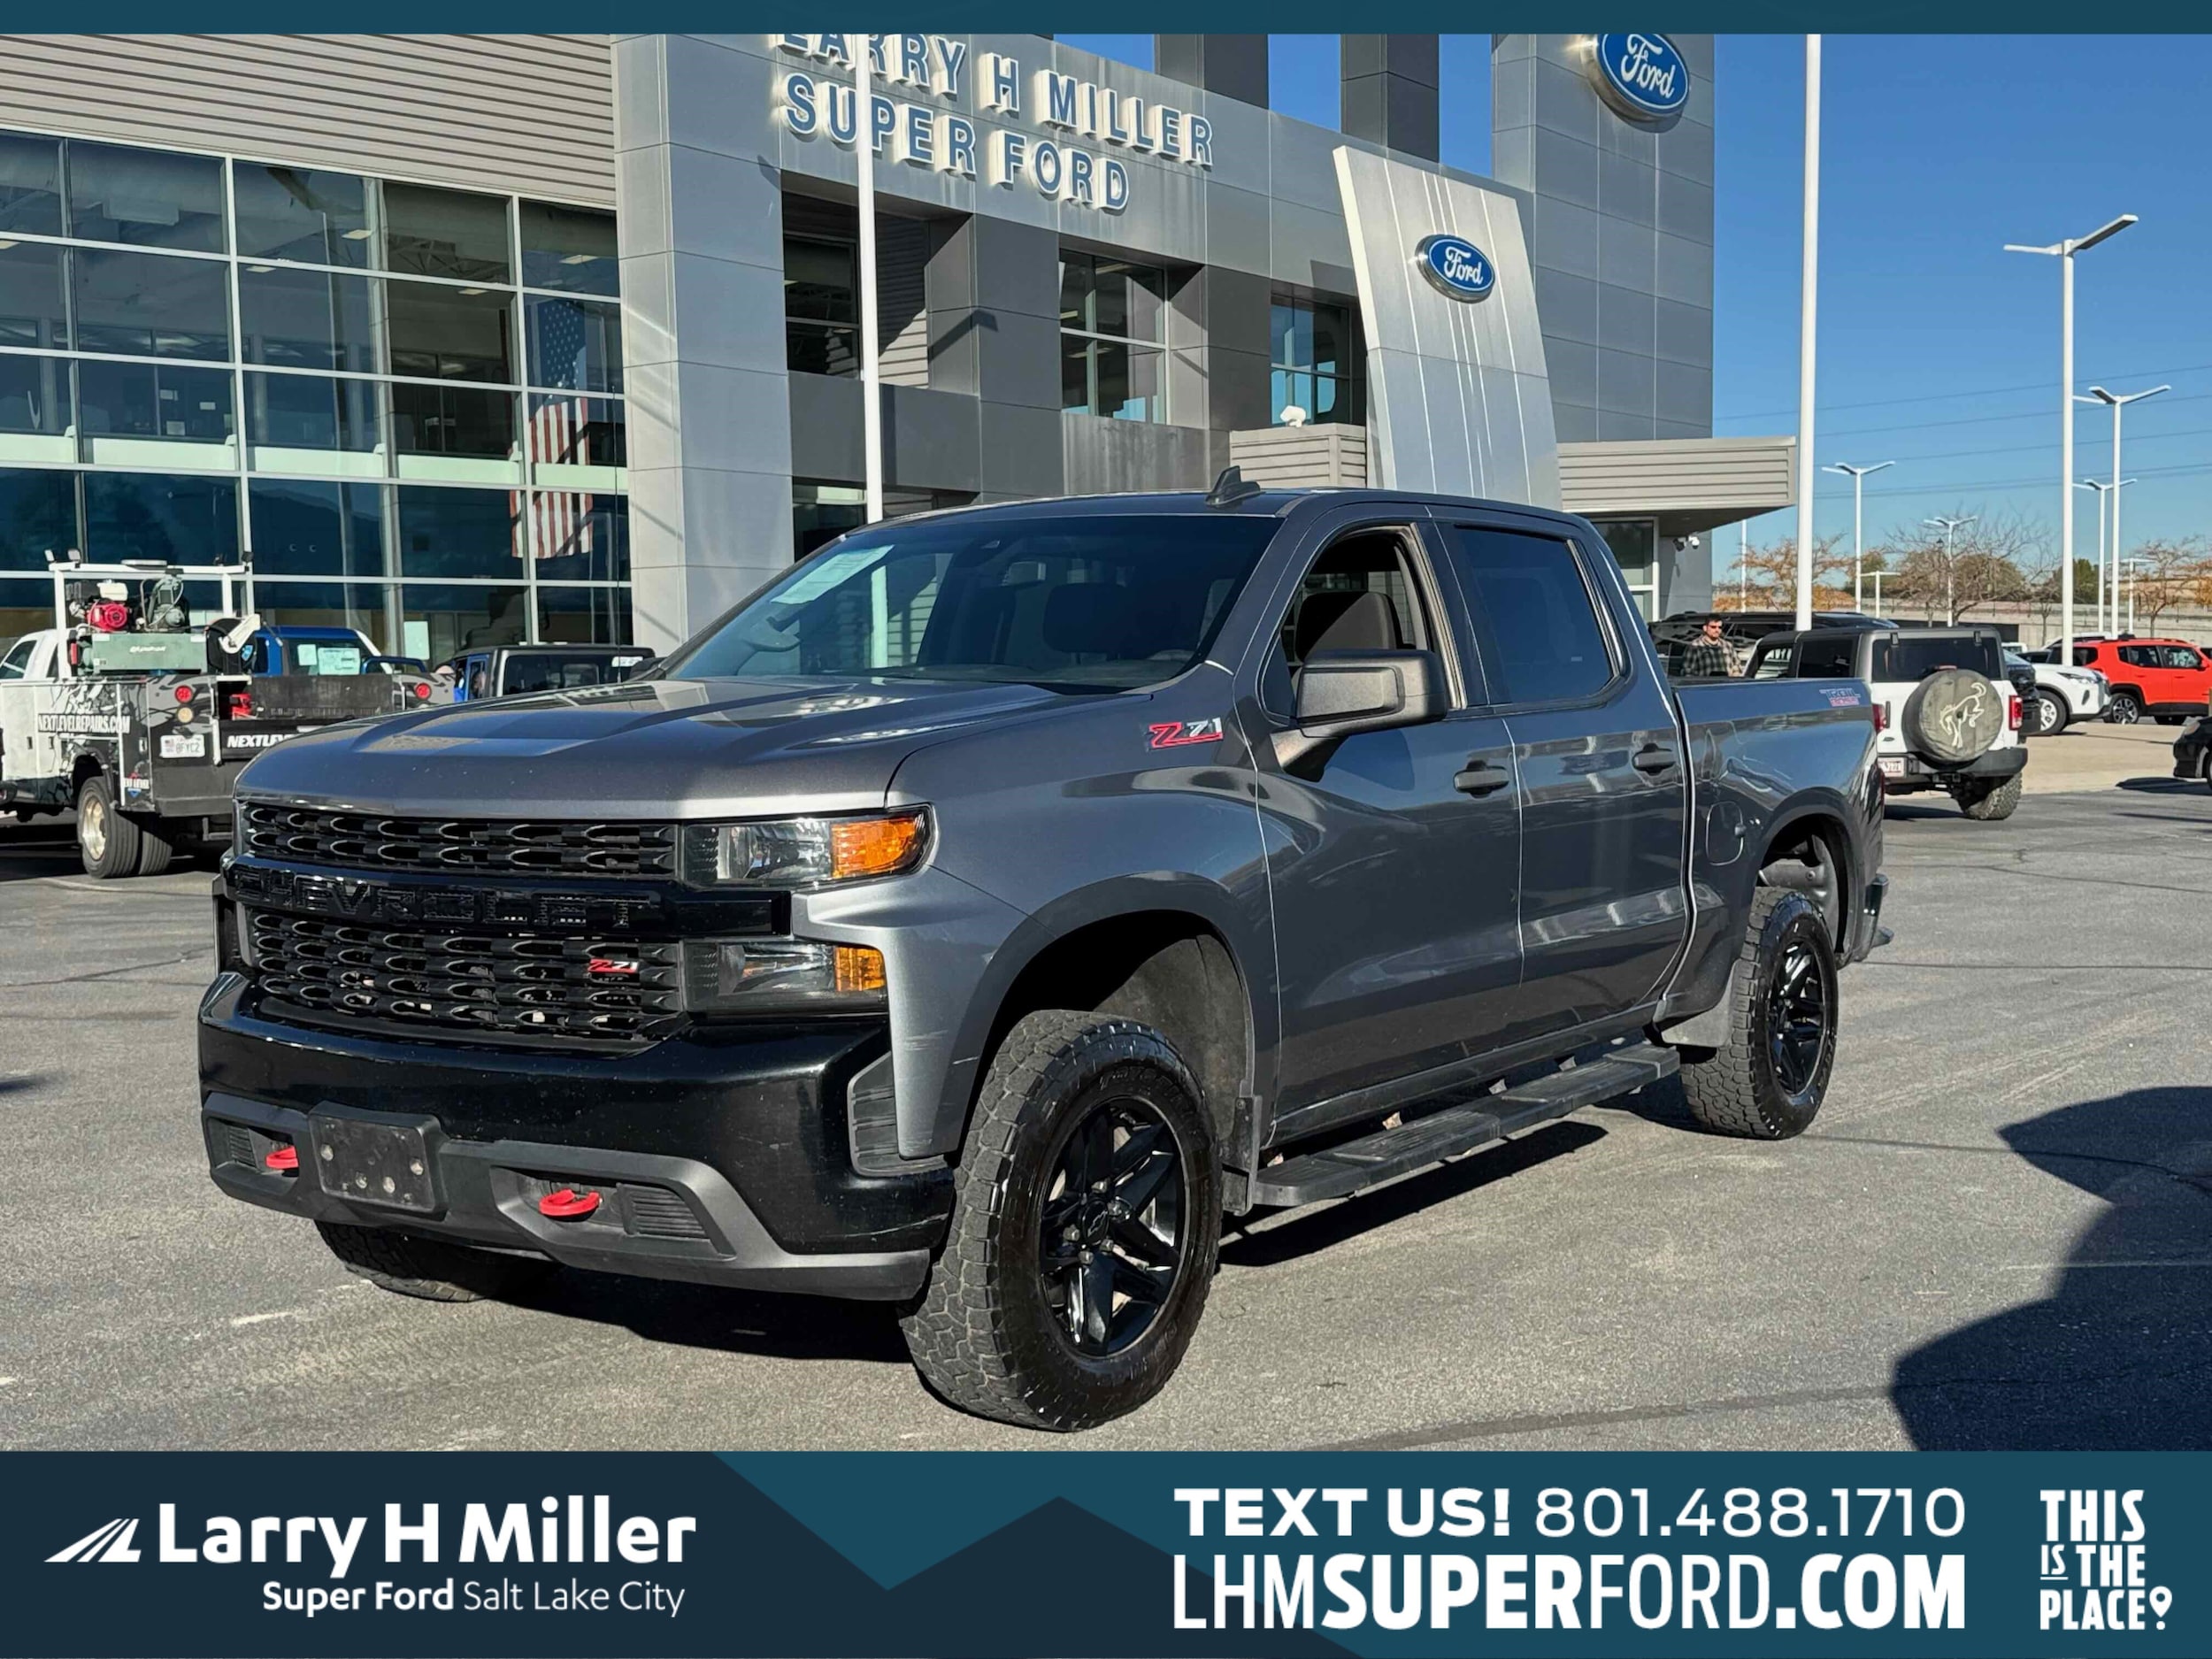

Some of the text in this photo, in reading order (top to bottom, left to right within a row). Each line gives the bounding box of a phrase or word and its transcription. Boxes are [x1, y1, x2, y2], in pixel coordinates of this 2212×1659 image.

[1621, 34, 1676, 98] Ford
[781, 34, 1214, 167] ARRY H MILLER
[781, 73, 1130, 211] SUPER FORD
[1443, 246, 1485, 286] Ford
[227, 734, 294, 749] NEXTLEV
[1148, 717, 1224, 748] Z71
[588, 958, 638, 973] Z71
